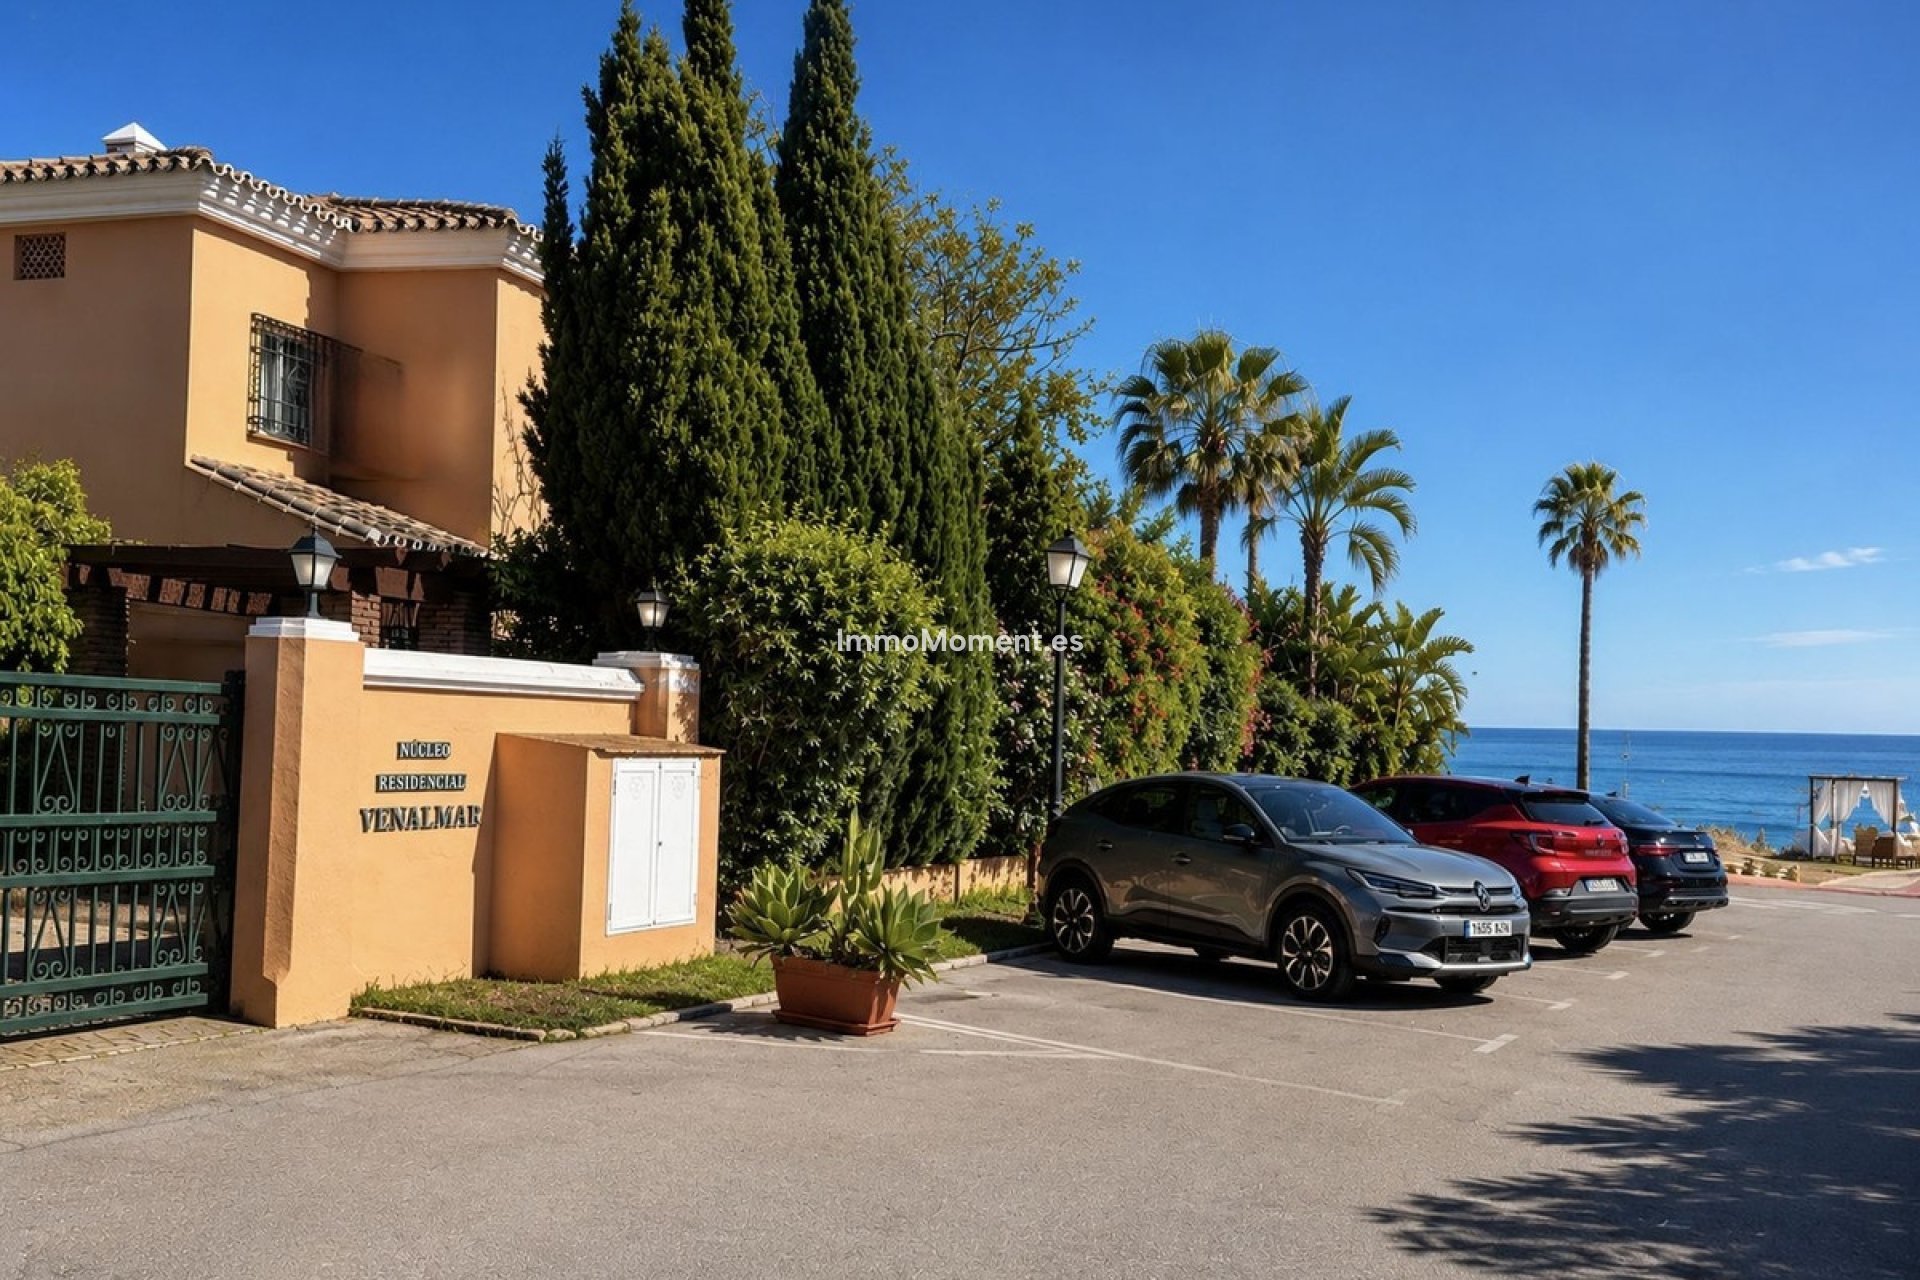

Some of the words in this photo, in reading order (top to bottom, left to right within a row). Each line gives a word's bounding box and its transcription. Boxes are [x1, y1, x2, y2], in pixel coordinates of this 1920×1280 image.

[399, 739, 451, 758] NÚCLEO
[378, 774, 466, 791] RESIDENCIAL
[360, 805, 482, 833] VENALMAR
